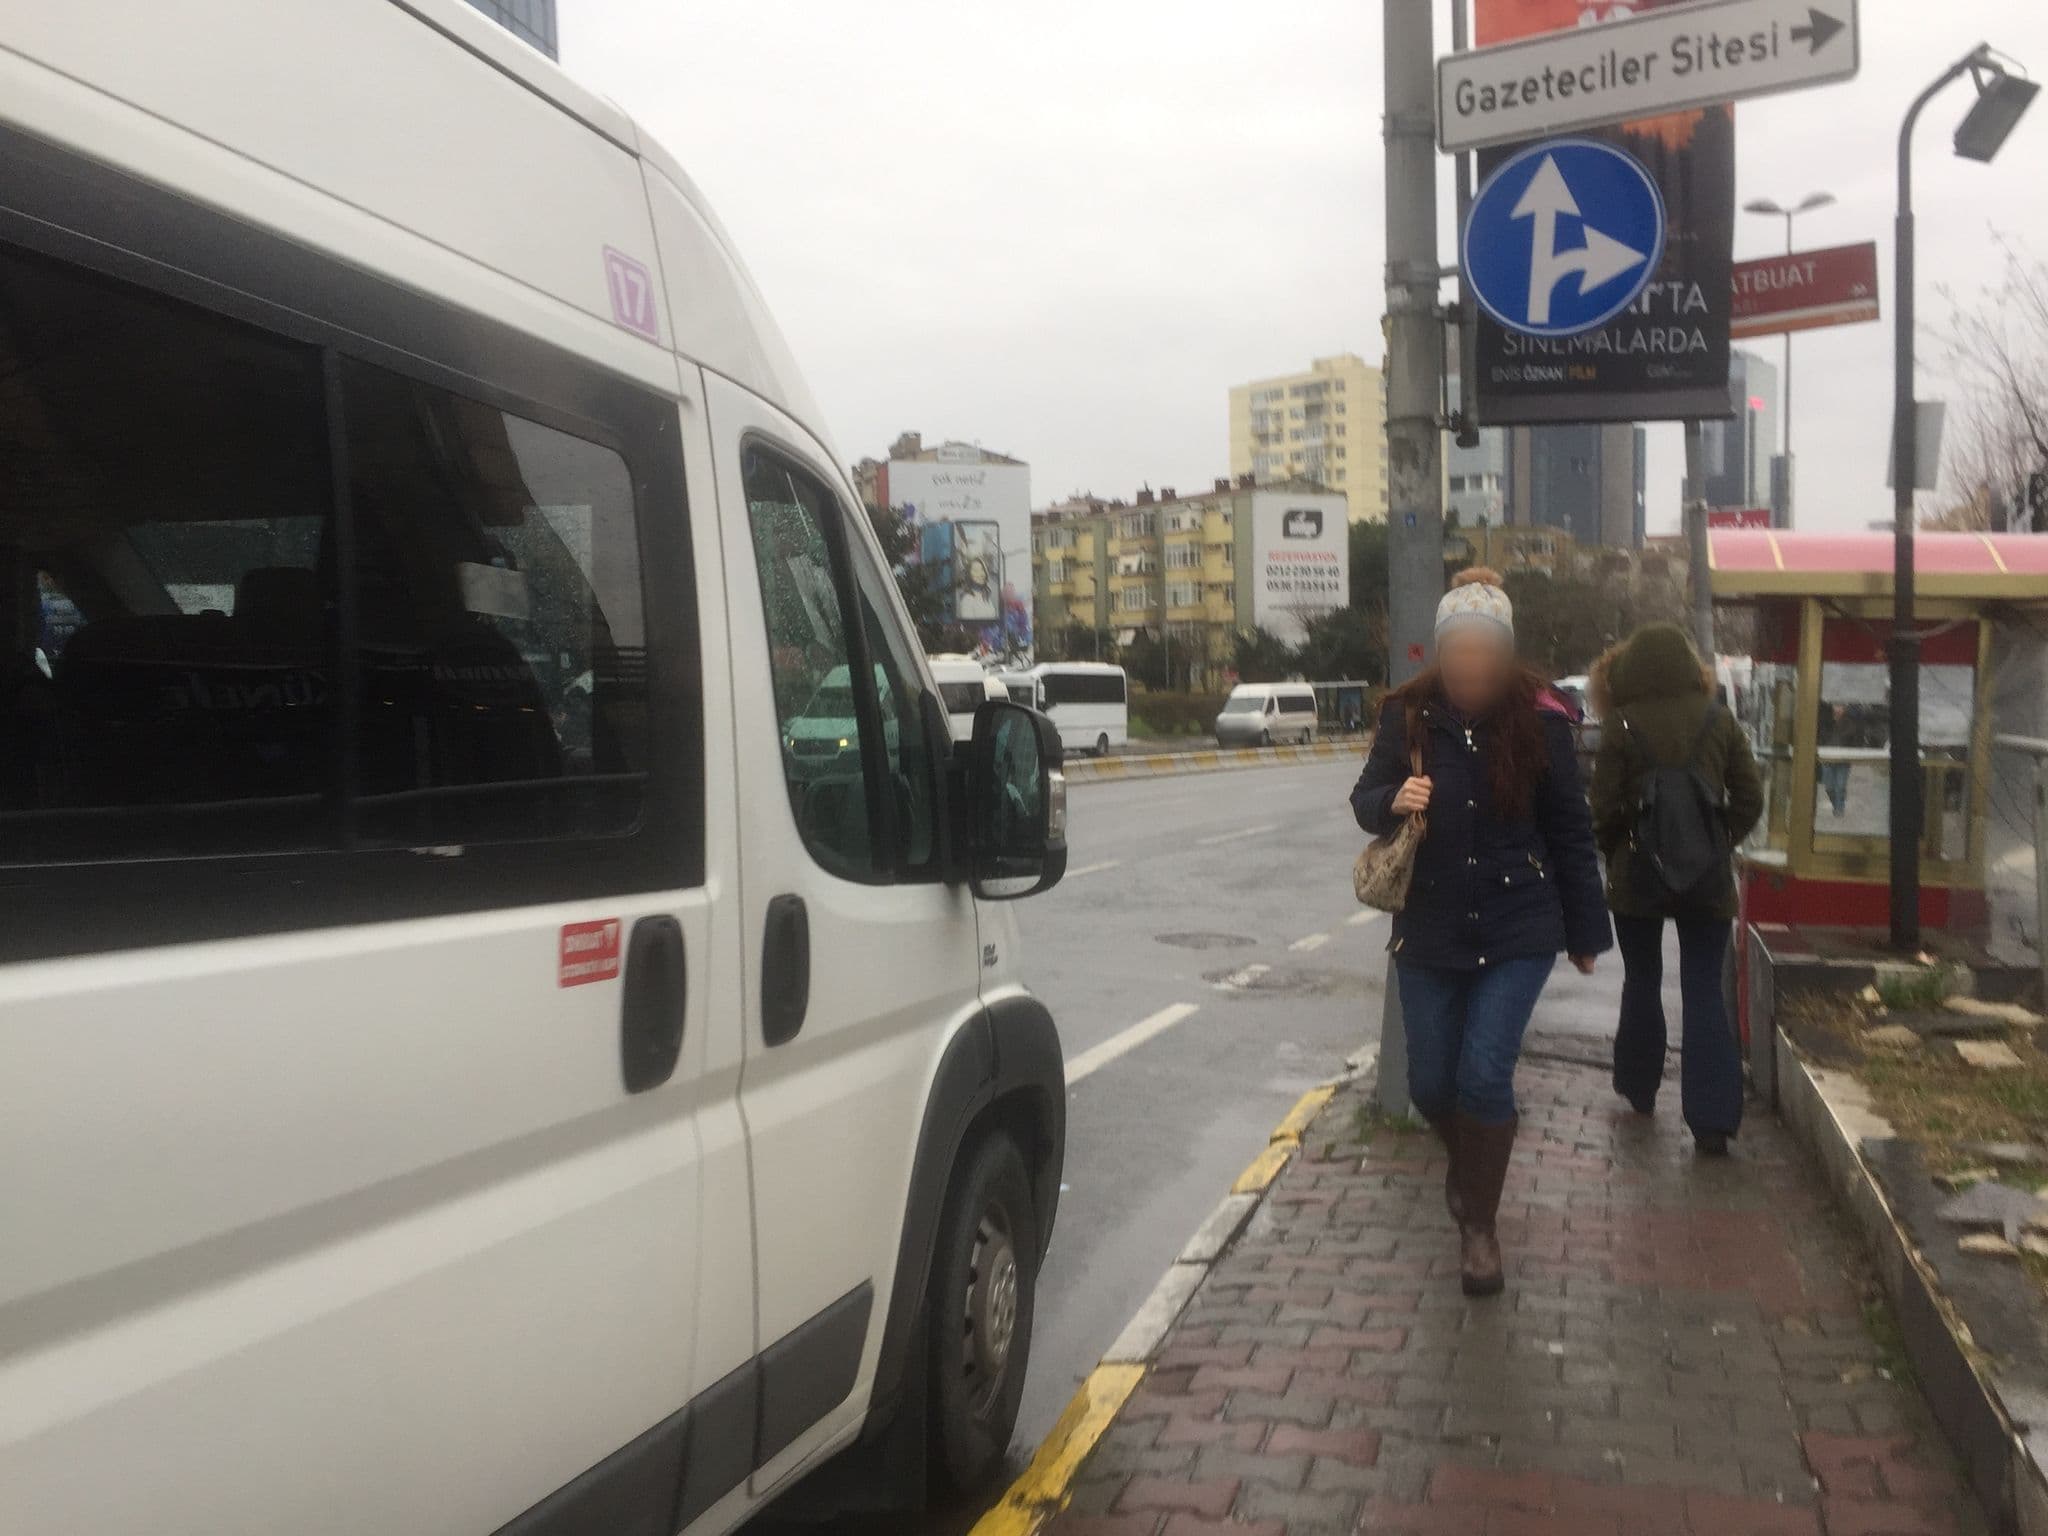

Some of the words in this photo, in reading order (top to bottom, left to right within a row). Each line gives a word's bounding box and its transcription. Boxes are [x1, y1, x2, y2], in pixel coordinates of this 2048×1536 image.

[1454, 50, 1660, 118] Gazeteciler
[1670, 20, 1780, 76] Sitesi
[611, 260, 646, 325] 17
